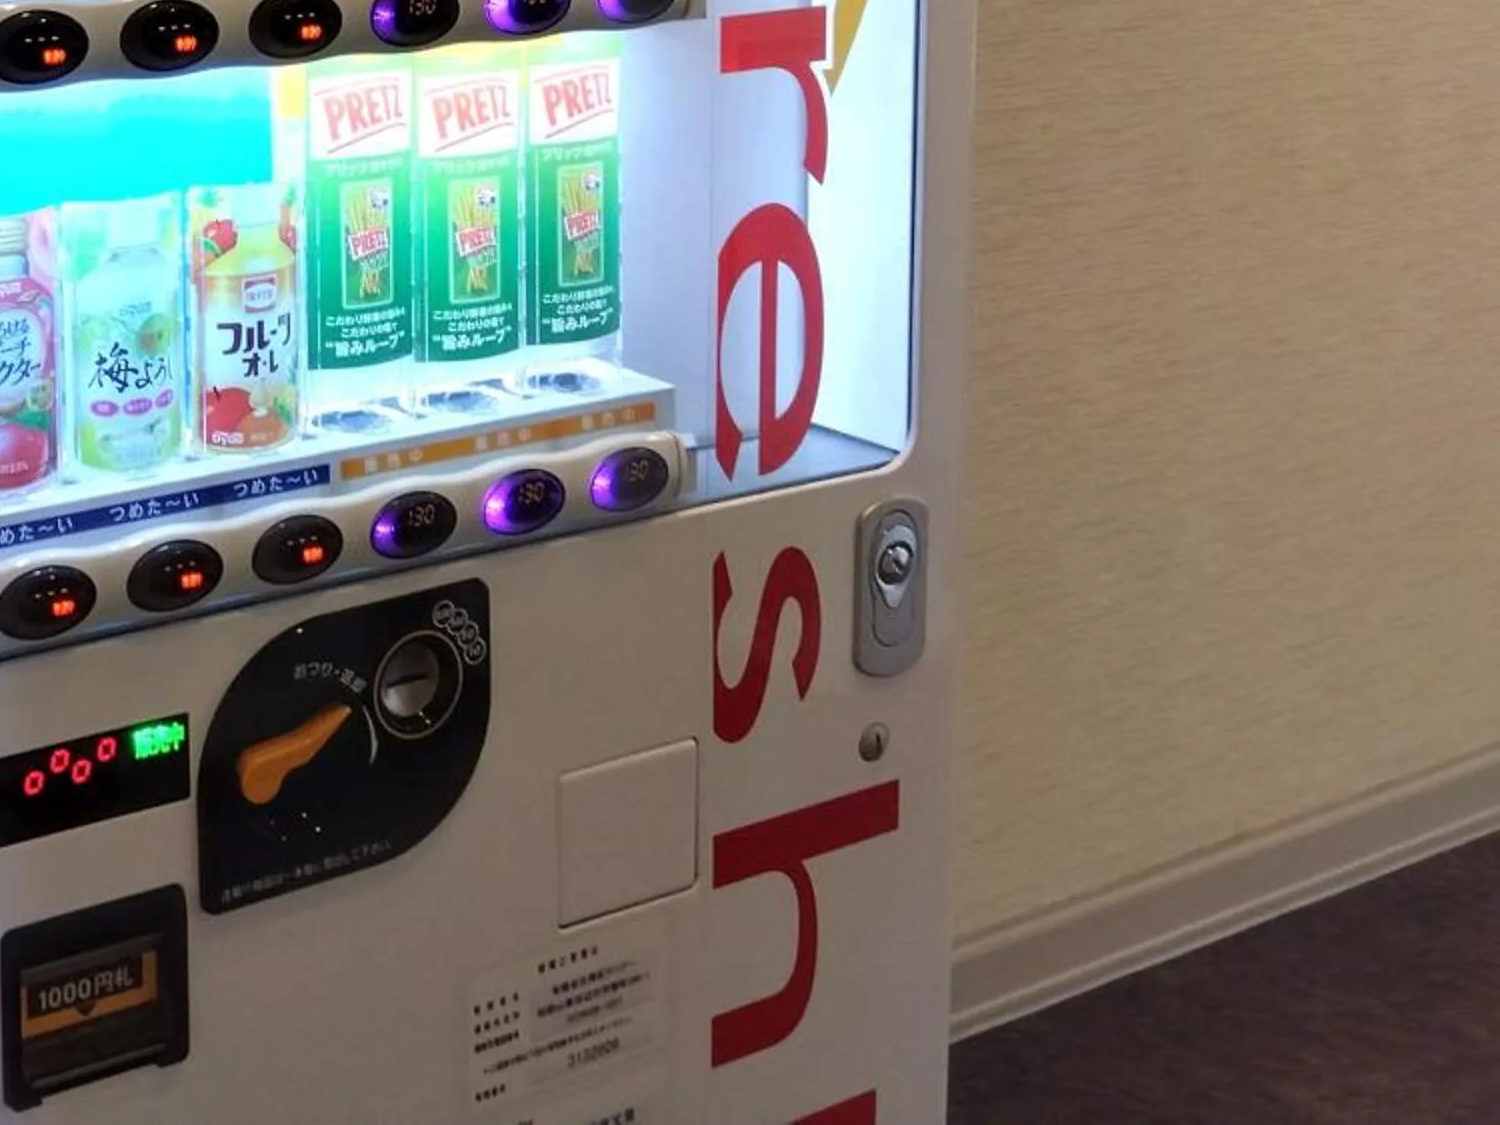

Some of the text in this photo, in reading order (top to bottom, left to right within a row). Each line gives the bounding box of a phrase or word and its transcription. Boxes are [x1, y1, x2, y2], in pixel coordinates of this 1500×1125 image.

[323, 79, 404, 142] PRETZ
[432, 78, 512, 141] PRETZ
[542, 71, 613, 128] PRETZ
[217, 312, 291, 355] フルーツ
[37, 966, 134, 1013] 1000円札
